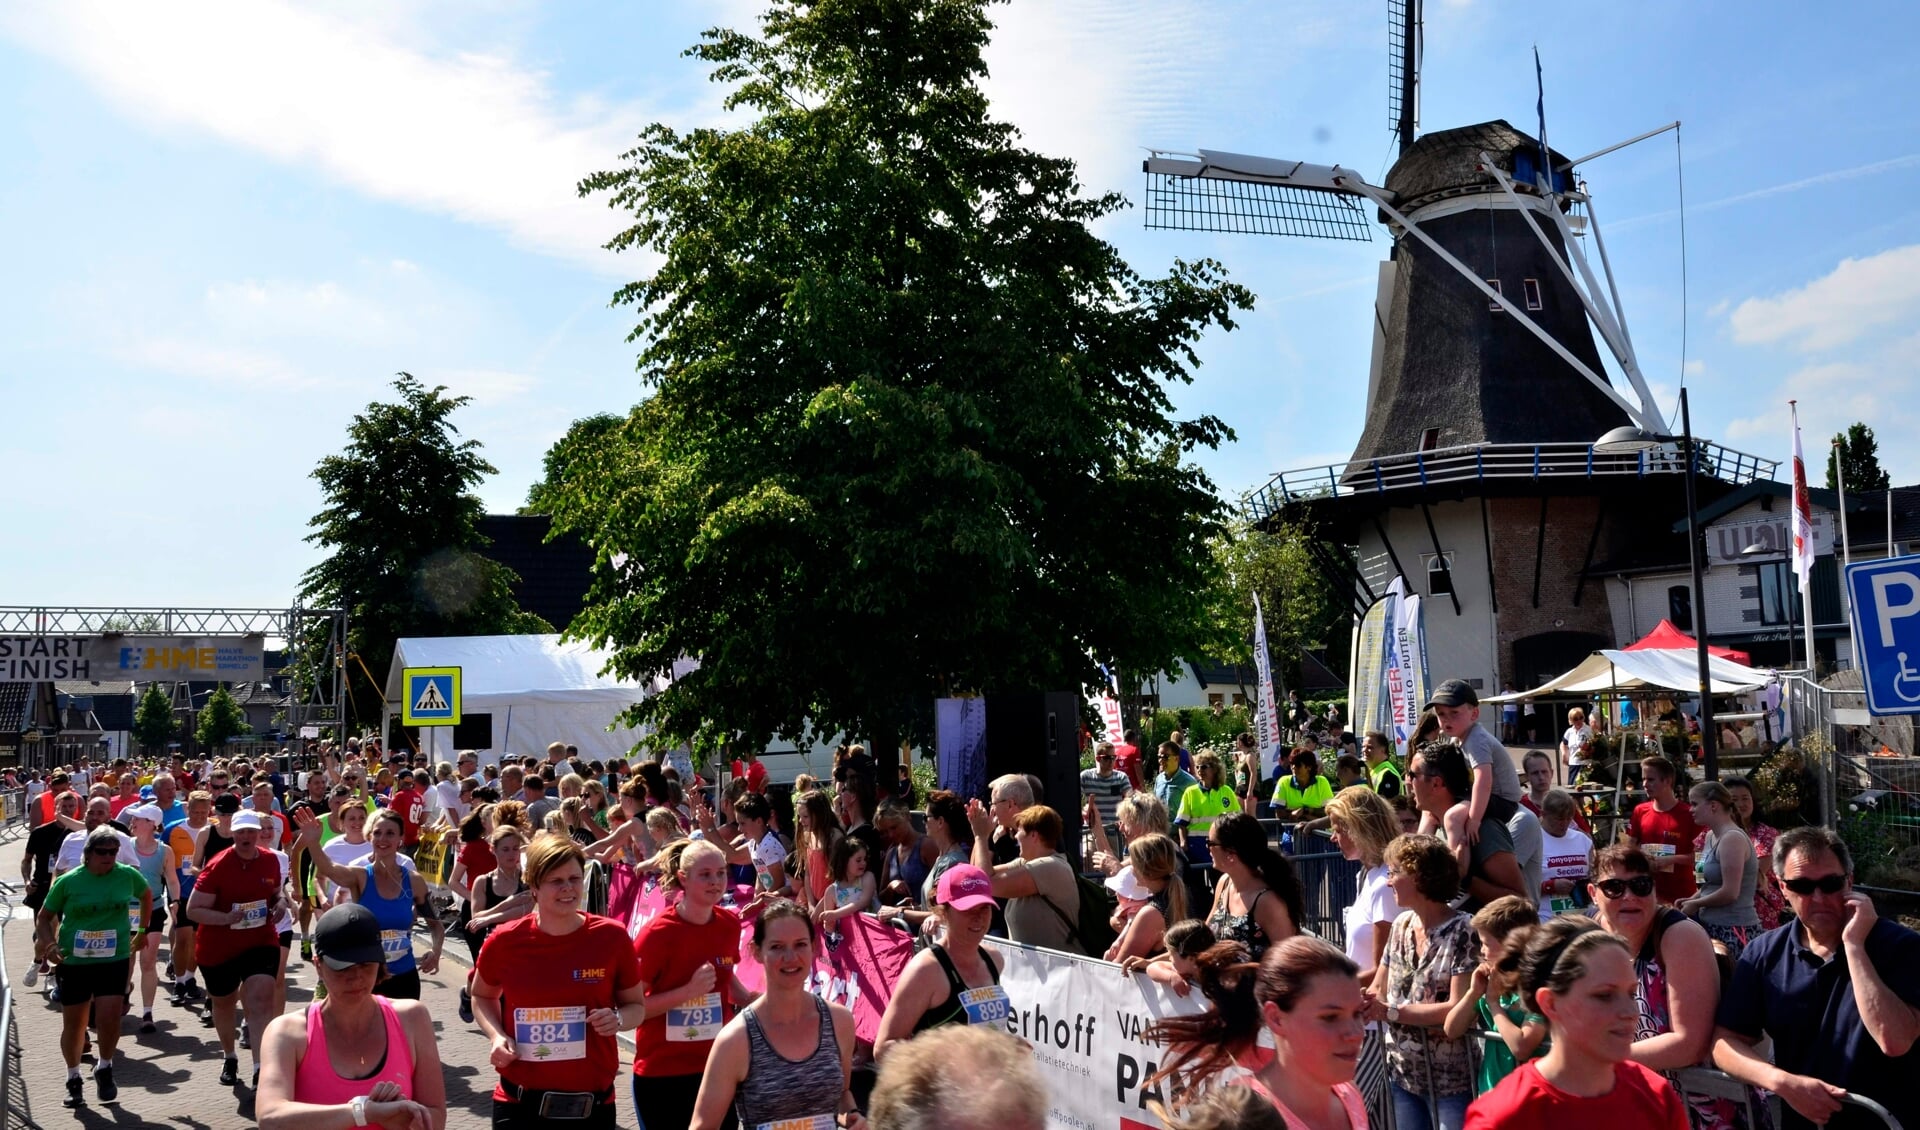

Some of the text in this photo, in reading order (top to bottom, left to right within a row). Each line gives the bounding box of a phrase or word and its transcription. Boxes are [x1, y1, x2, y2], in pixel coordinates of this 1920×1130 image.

[1871, 571, 1920, 648] P
[0, 638, 88, 657] START
[1398, 627, 1411, 669] PUTTEN
[1407, 680, 1416, 726] ERMELO
[84, 939, 108, 949] 709
[526, 1007, 563, 1022] HME
[681, 1008, 713, 1026] 793
[978, 1000, 1005, 1021] 899
[530, 1024, 571, 1043] 884
[1007, 1003, 1096, 1056] erhoff
